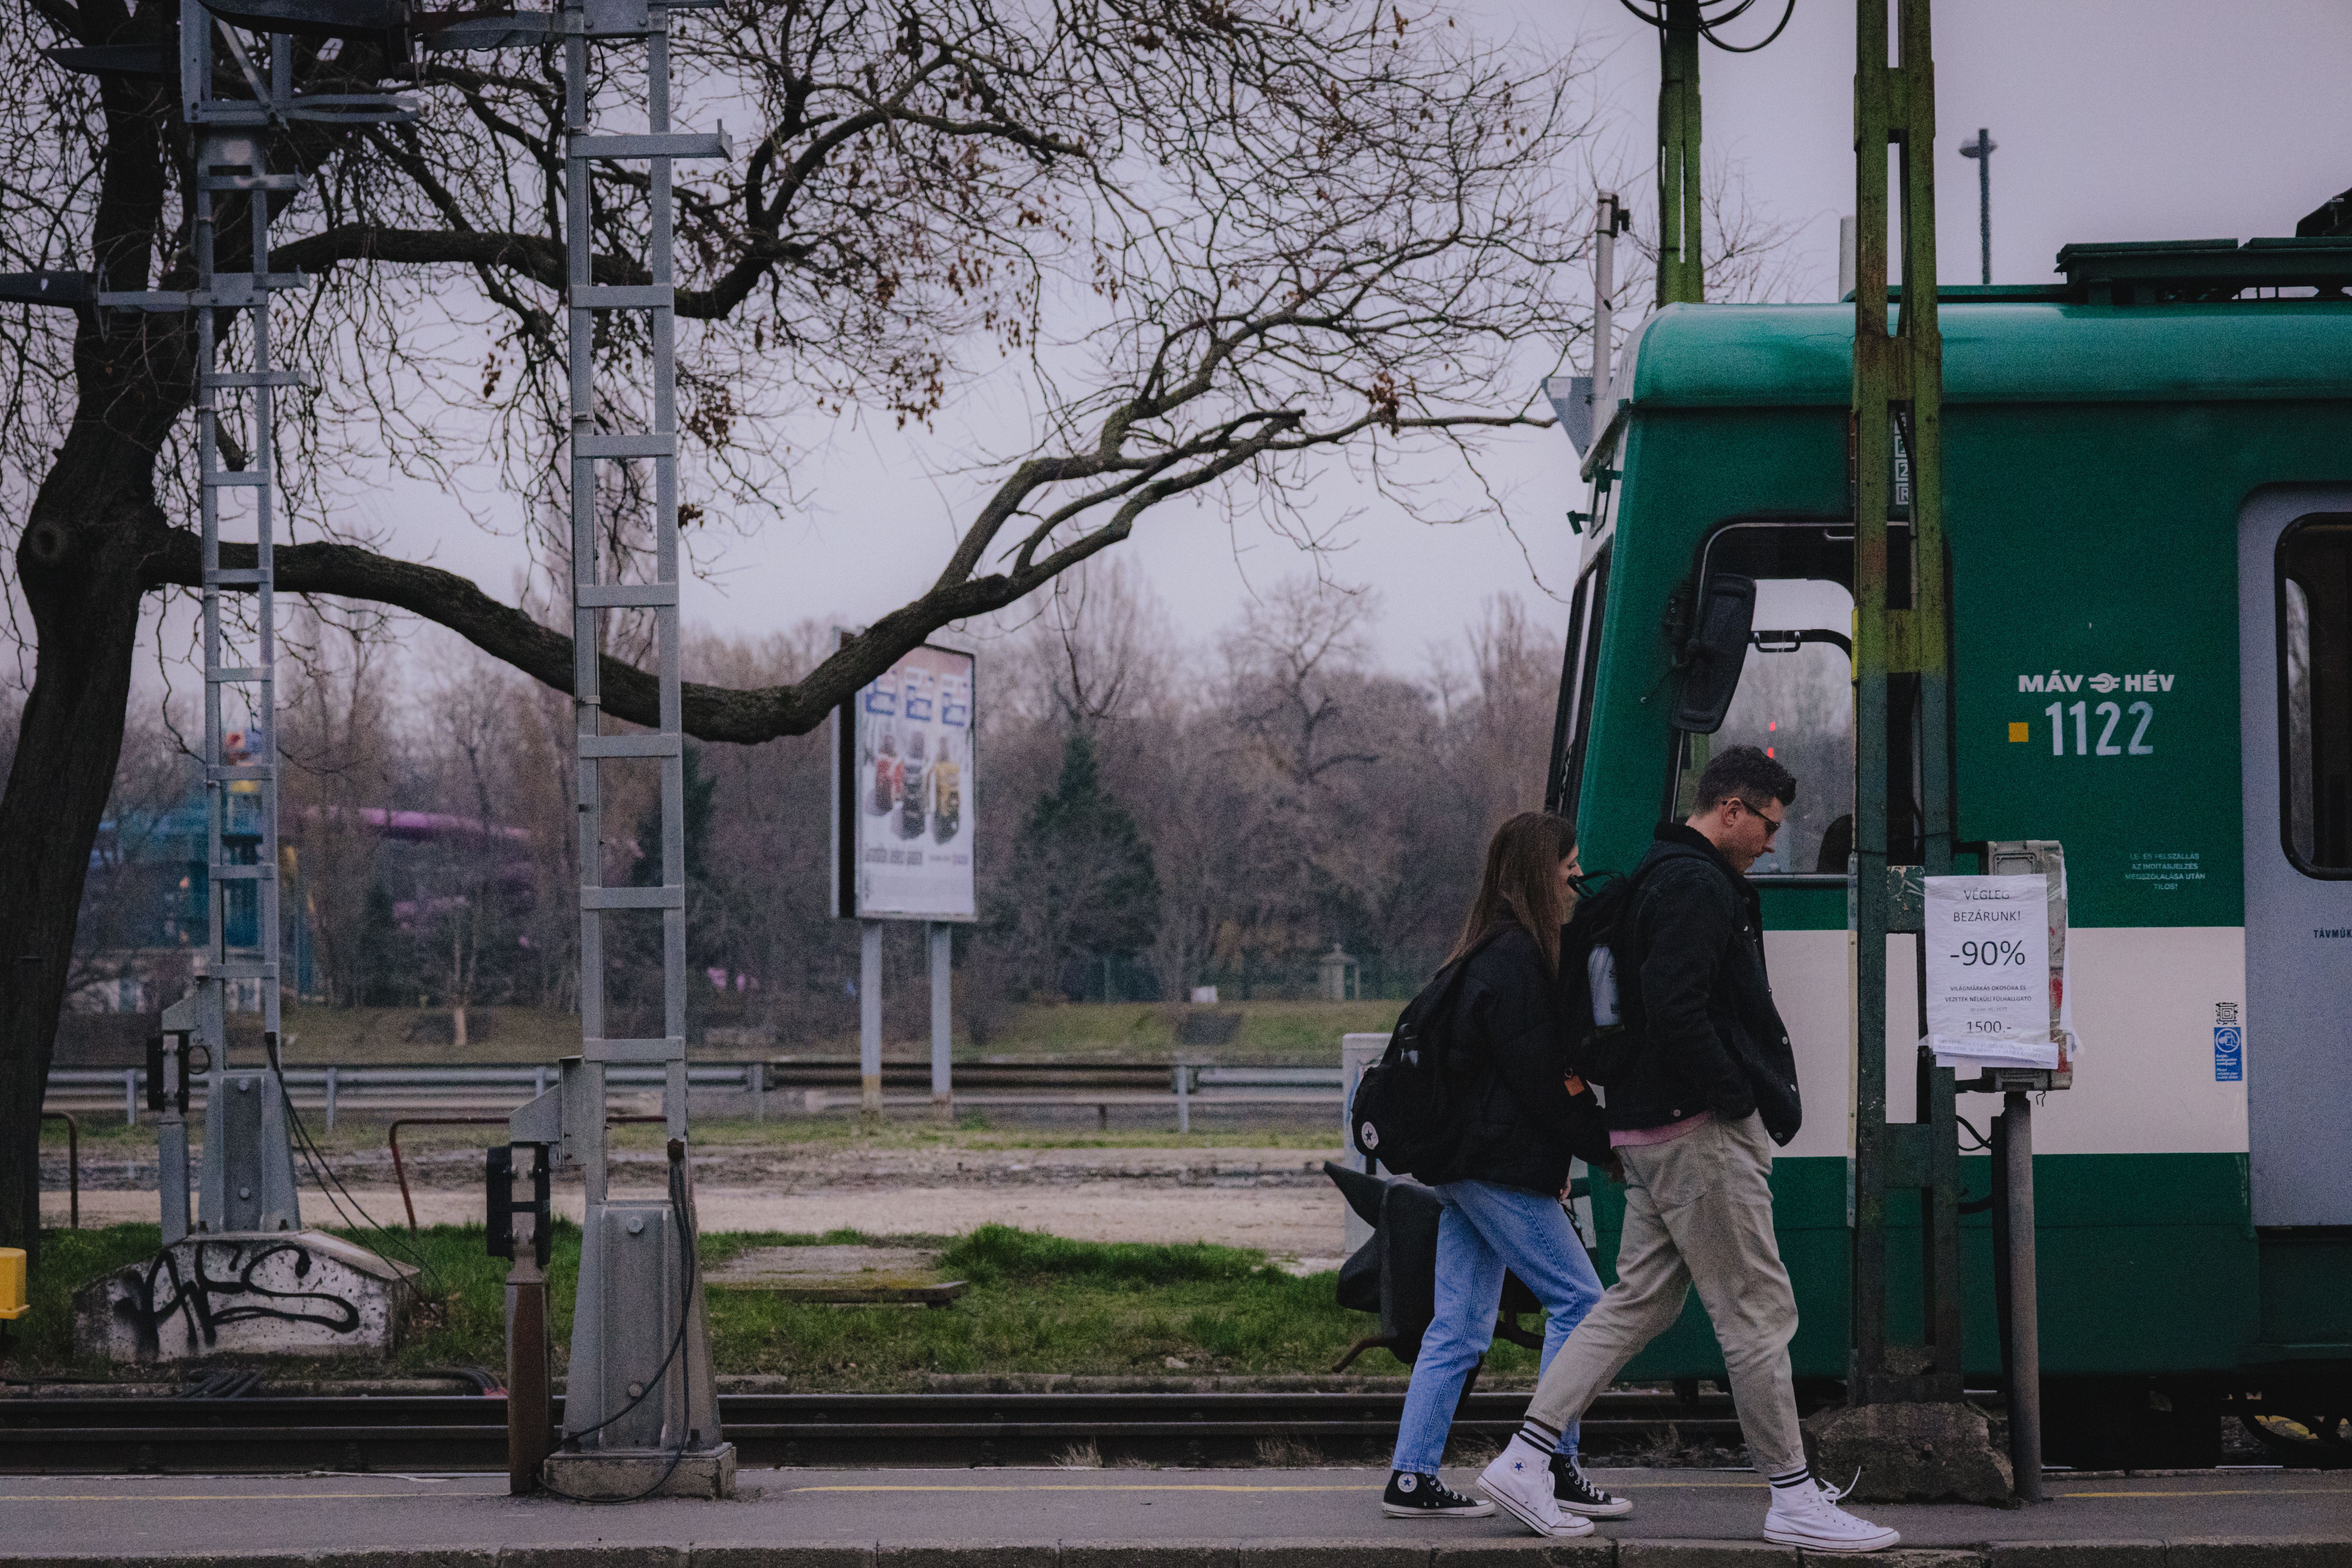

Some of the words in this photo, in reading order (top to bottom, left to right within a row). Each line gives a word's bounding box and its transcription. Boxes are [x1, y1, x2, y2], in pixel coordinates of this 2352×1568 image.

[2018, 670, 2083, 692] MÁV
[2125, 670, 2175, 692] HÉV
[2045, 701, 2153, 755] 1122
[1964, 887, 2009, 900] VÉGLEG
[1954, 909, 2020, 922] BEZÁRUNK!
[1950, 940, 2025, 966] -90%
[1966, 1021, 2011, 1033] 1500.-
